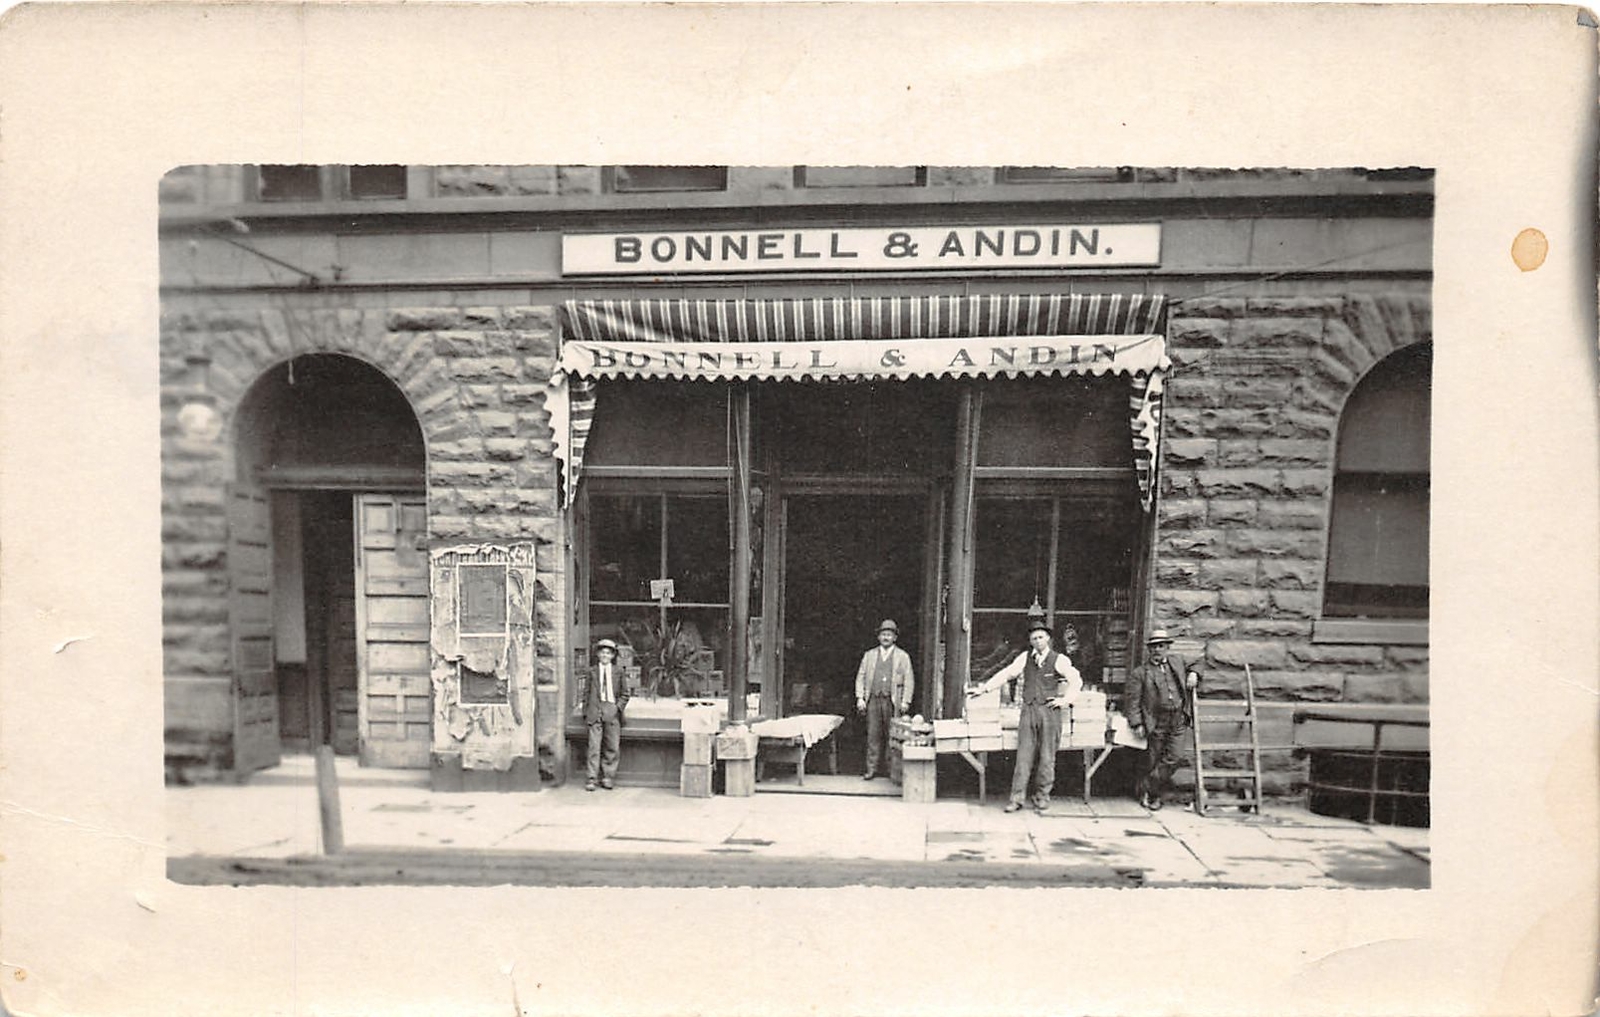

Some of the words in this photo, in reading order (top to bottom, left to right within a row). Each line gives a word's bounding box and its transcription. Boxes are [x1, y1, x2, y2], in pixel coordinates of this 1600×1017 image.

[614, 233, 858, 263] BONNELL
[883, 232, 919, 258] &
[938, 229, 1113, 257] ANDIN.
[588, 348, 838, 370] BONNELL
[880, 349, 905, 368] &
[948, 344, 1118, 367] ANDIN
